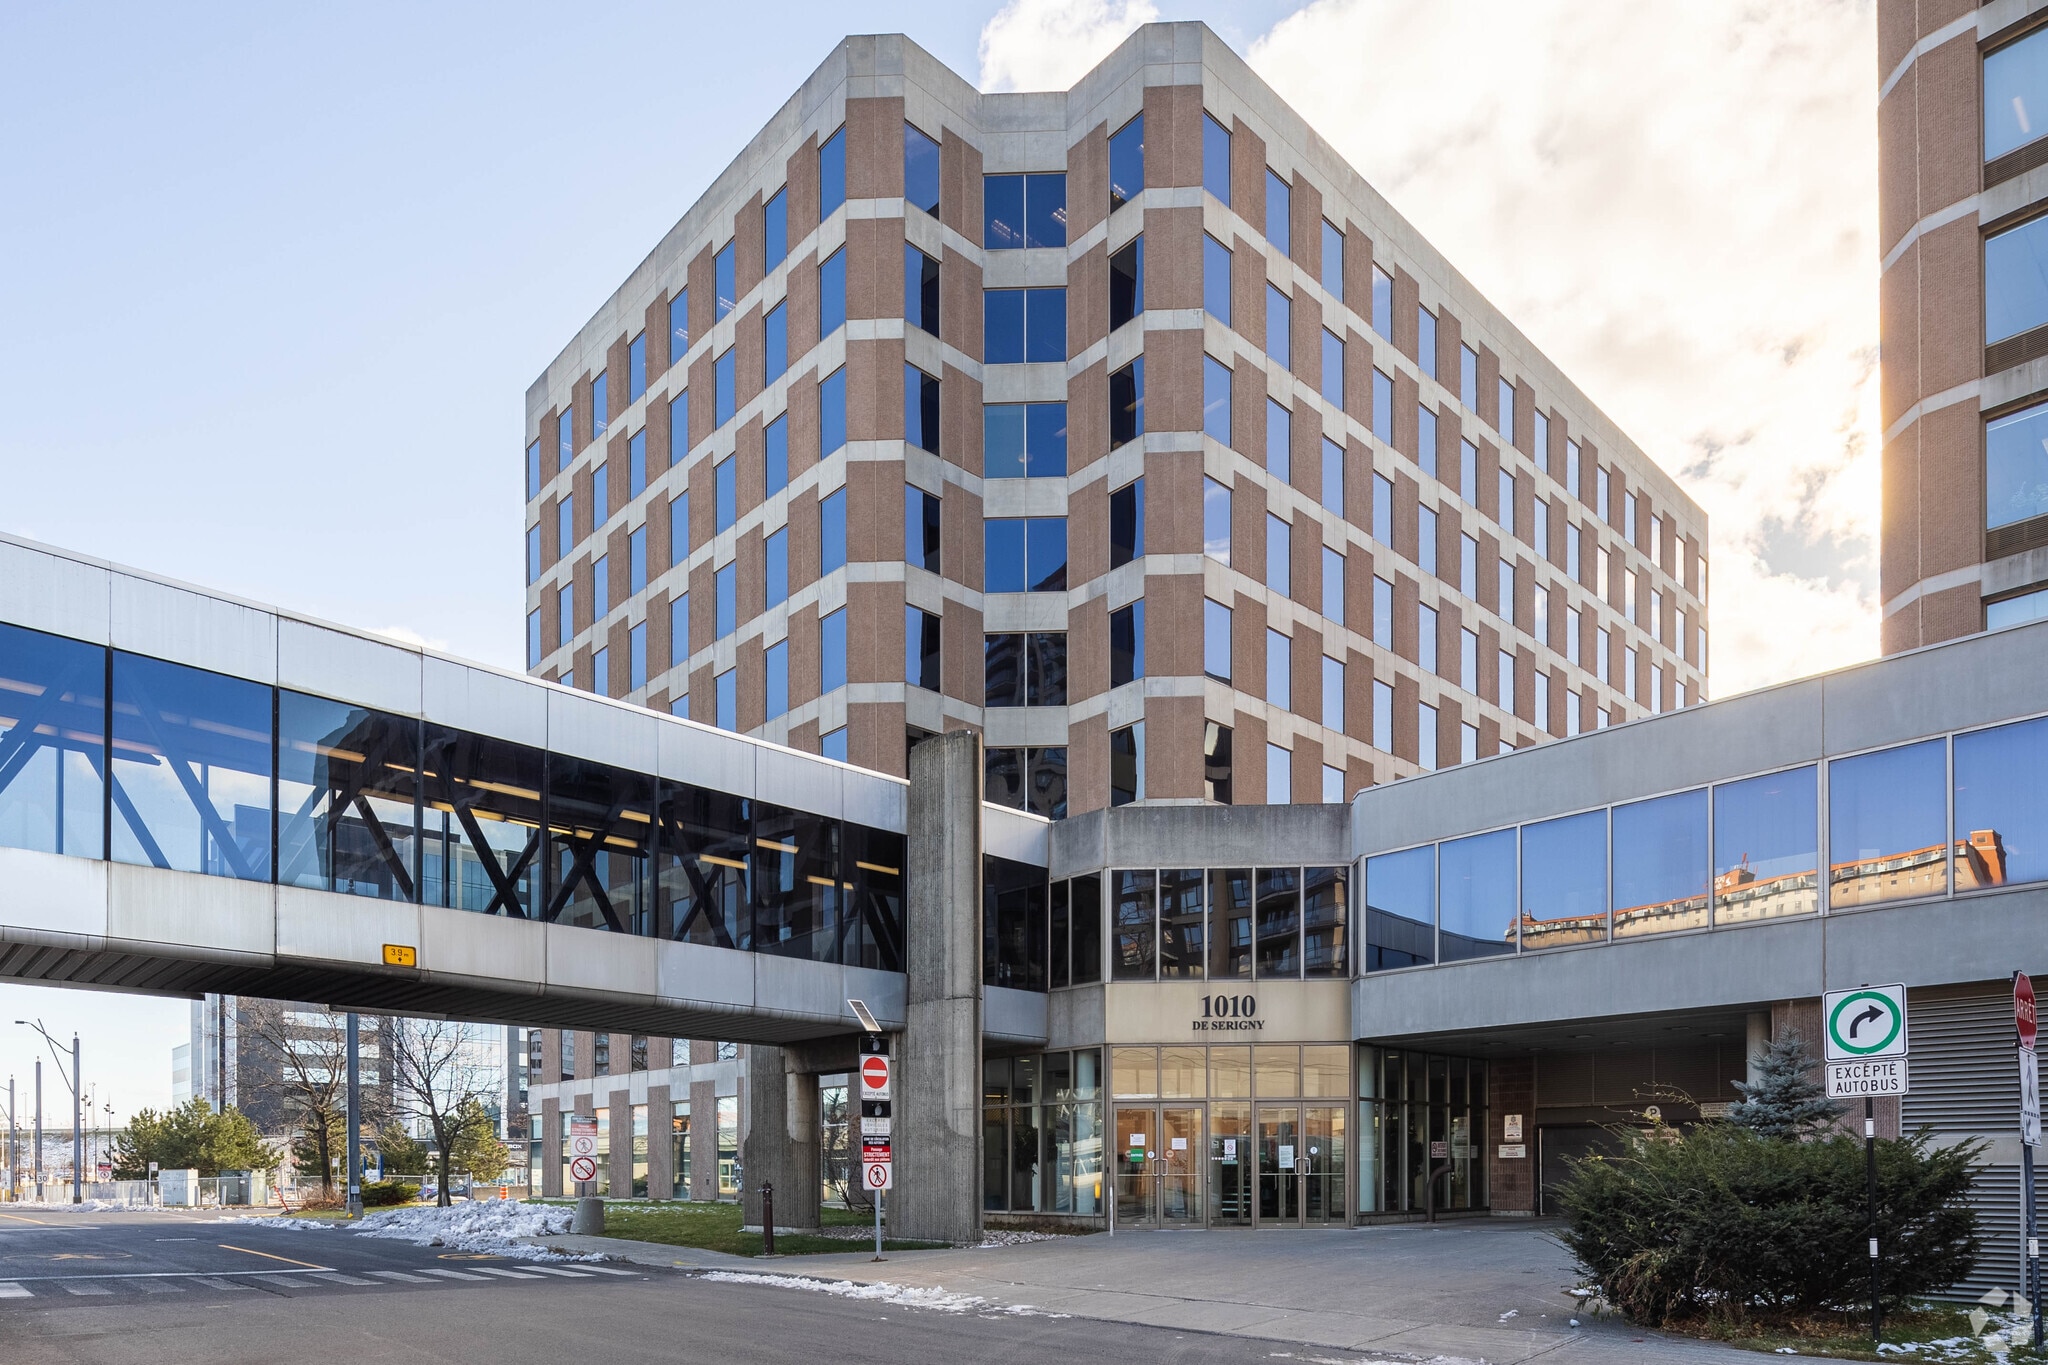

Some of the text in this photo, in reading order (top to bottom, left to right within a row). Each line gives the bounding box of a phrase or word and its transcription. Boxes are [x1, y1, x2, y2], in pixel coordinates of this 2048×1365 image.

[1201, 994, 1256, 1018] 1010
[2016, 997, 2036, 1025] ARRÊT
[1192, 1020, 1265, 1031] DE SERIGNY
[1835, 1078, 1899, 1094] AUTOBUS
